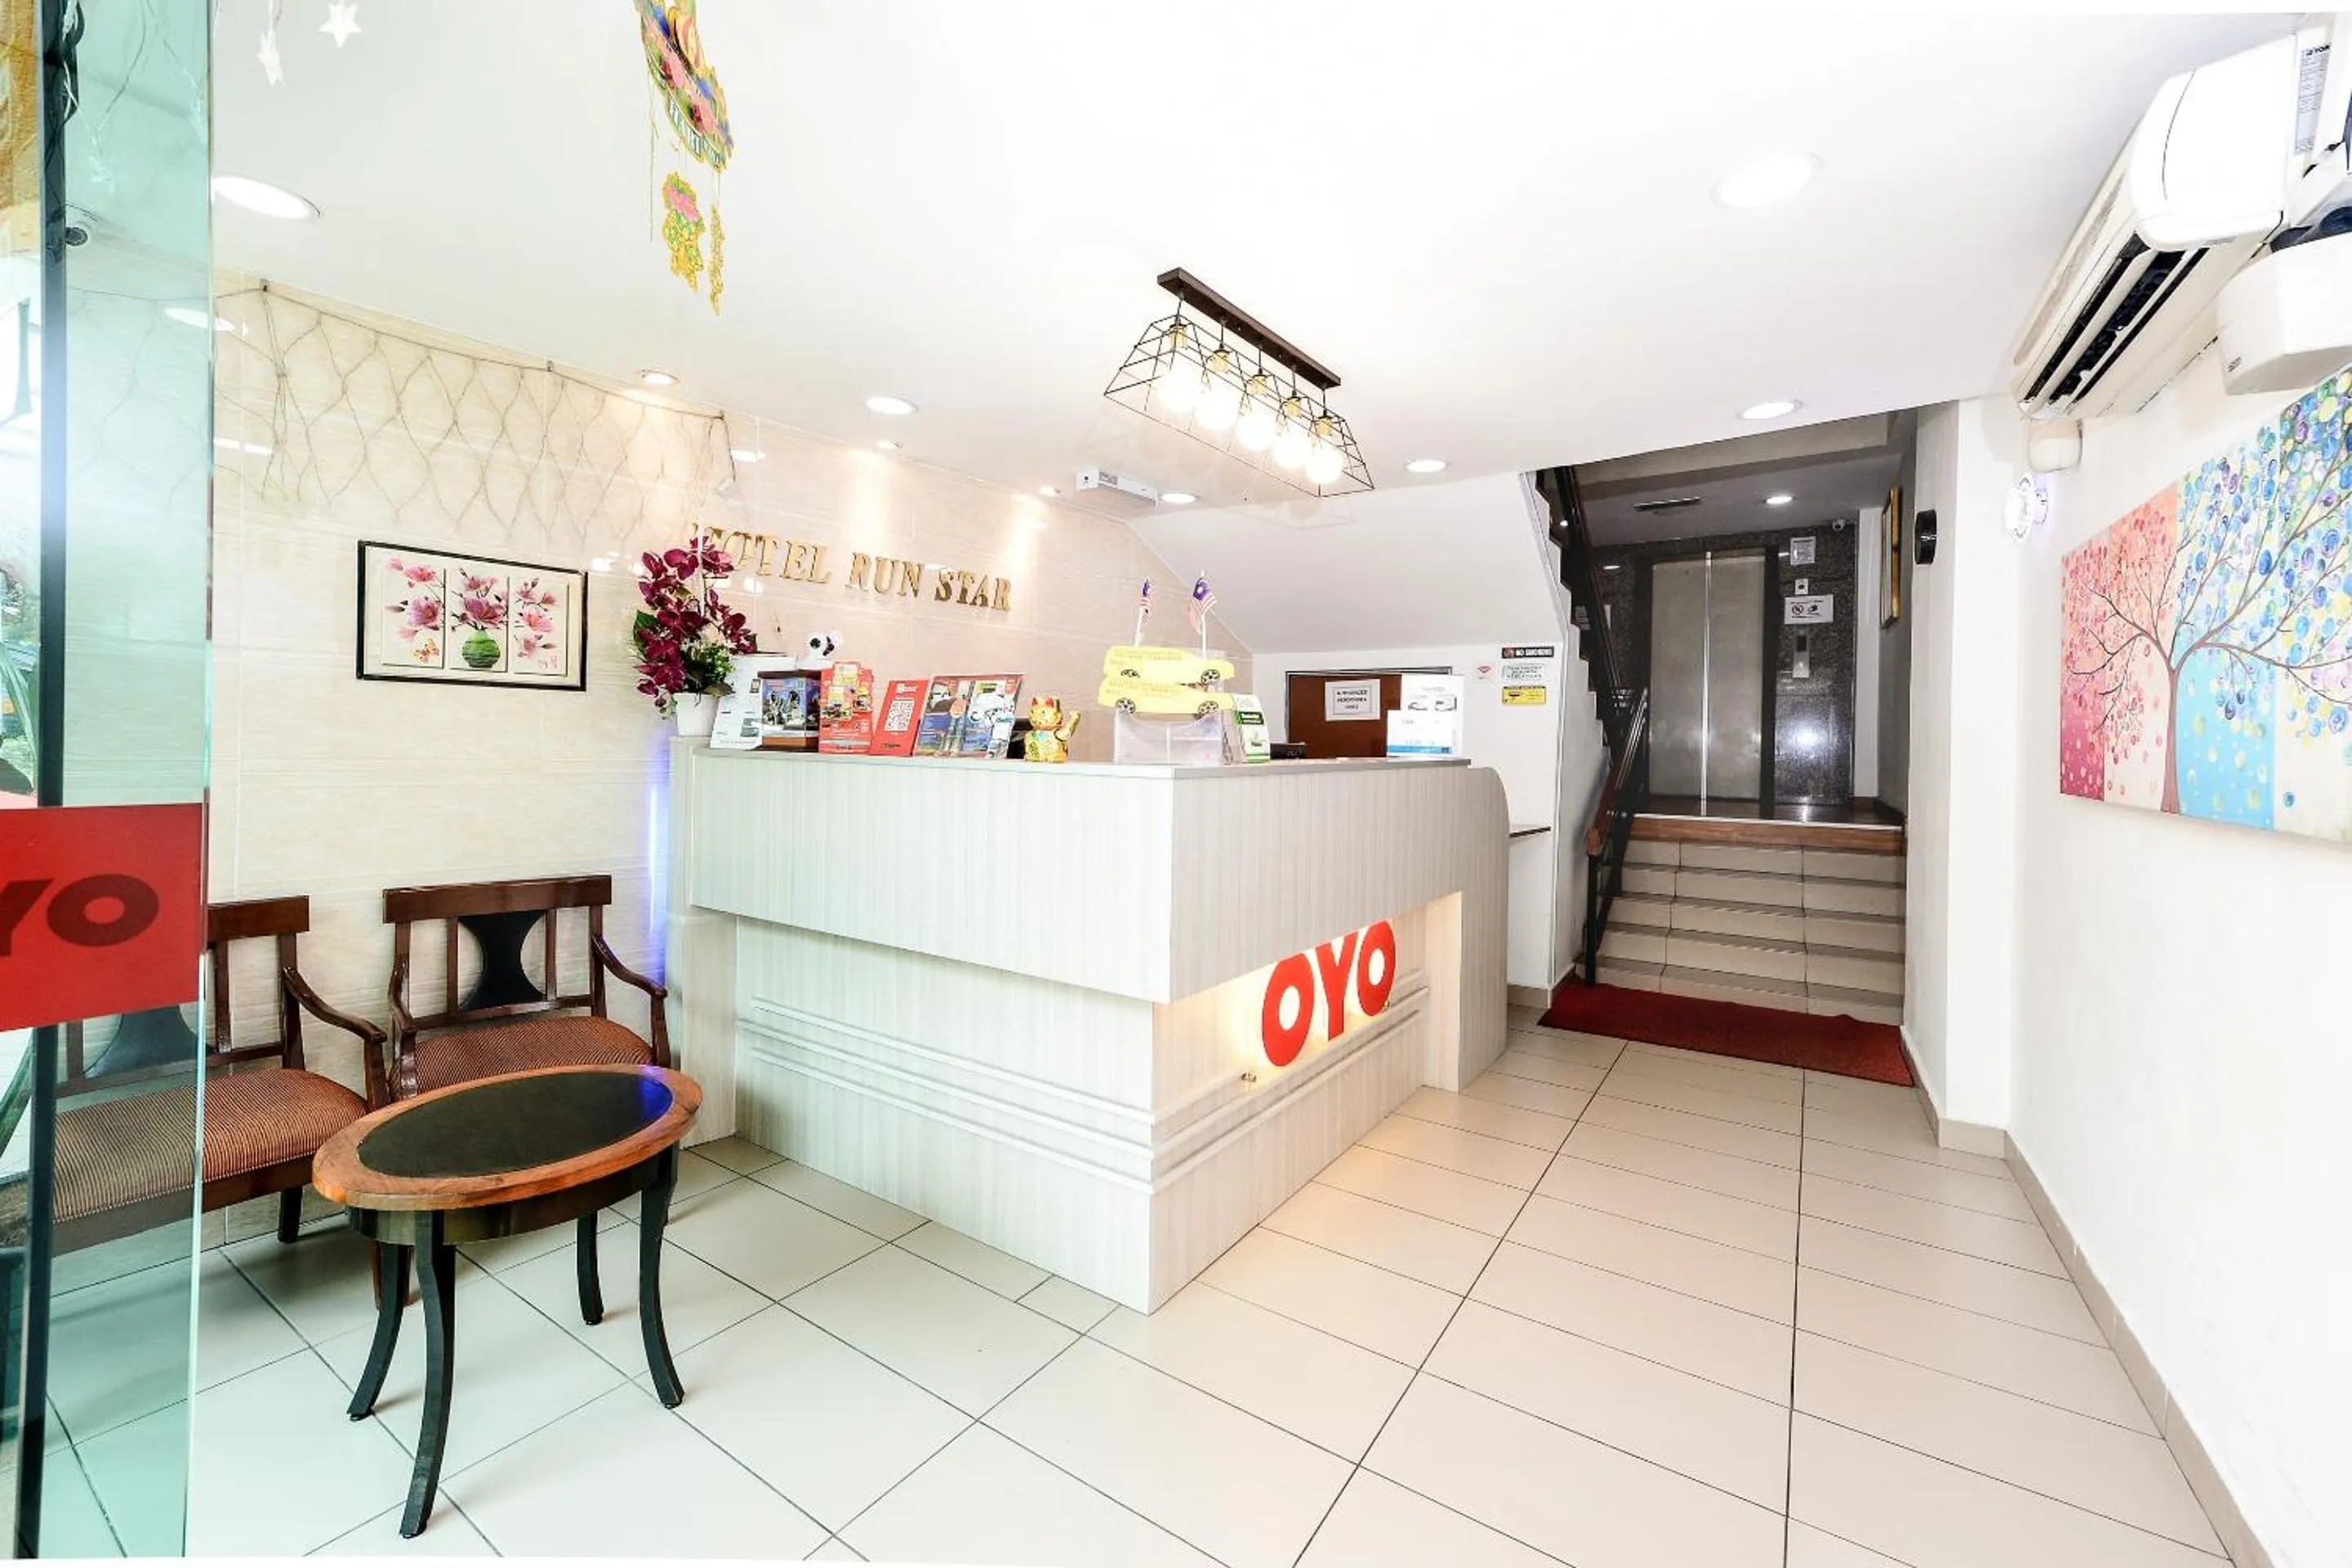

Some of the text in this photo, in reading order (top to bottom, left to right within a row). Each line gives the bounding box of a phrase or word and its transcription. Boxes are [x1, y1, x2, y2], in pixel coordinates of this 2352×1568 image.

[692, 523, 1012, 611] OTEL RUN STAR
[1262, 920, 1396, 1067] OYO
